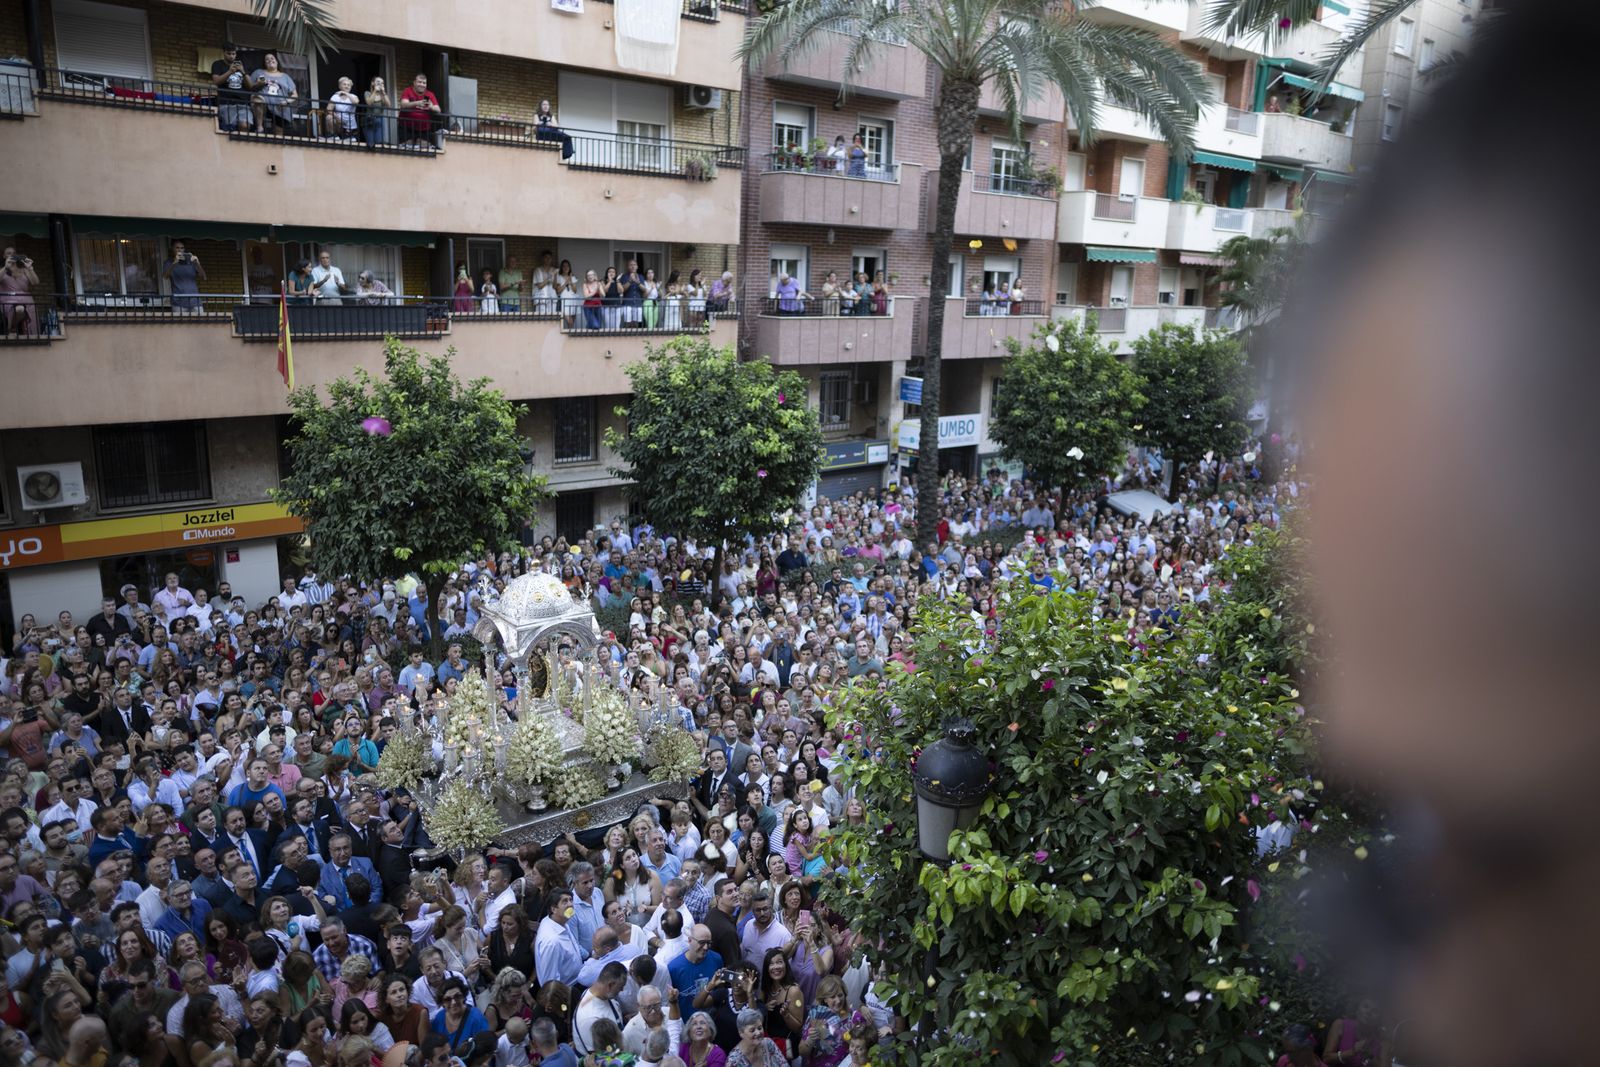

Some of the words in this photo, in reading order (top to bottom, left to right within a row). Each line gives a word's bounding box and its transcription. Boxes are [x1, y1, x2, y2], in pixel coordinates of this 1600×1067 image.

[939, 419, 975, 438] UMBO
[182, 508, 235, 526] Jazztel
[197, 526, 235, 539] Mundo
